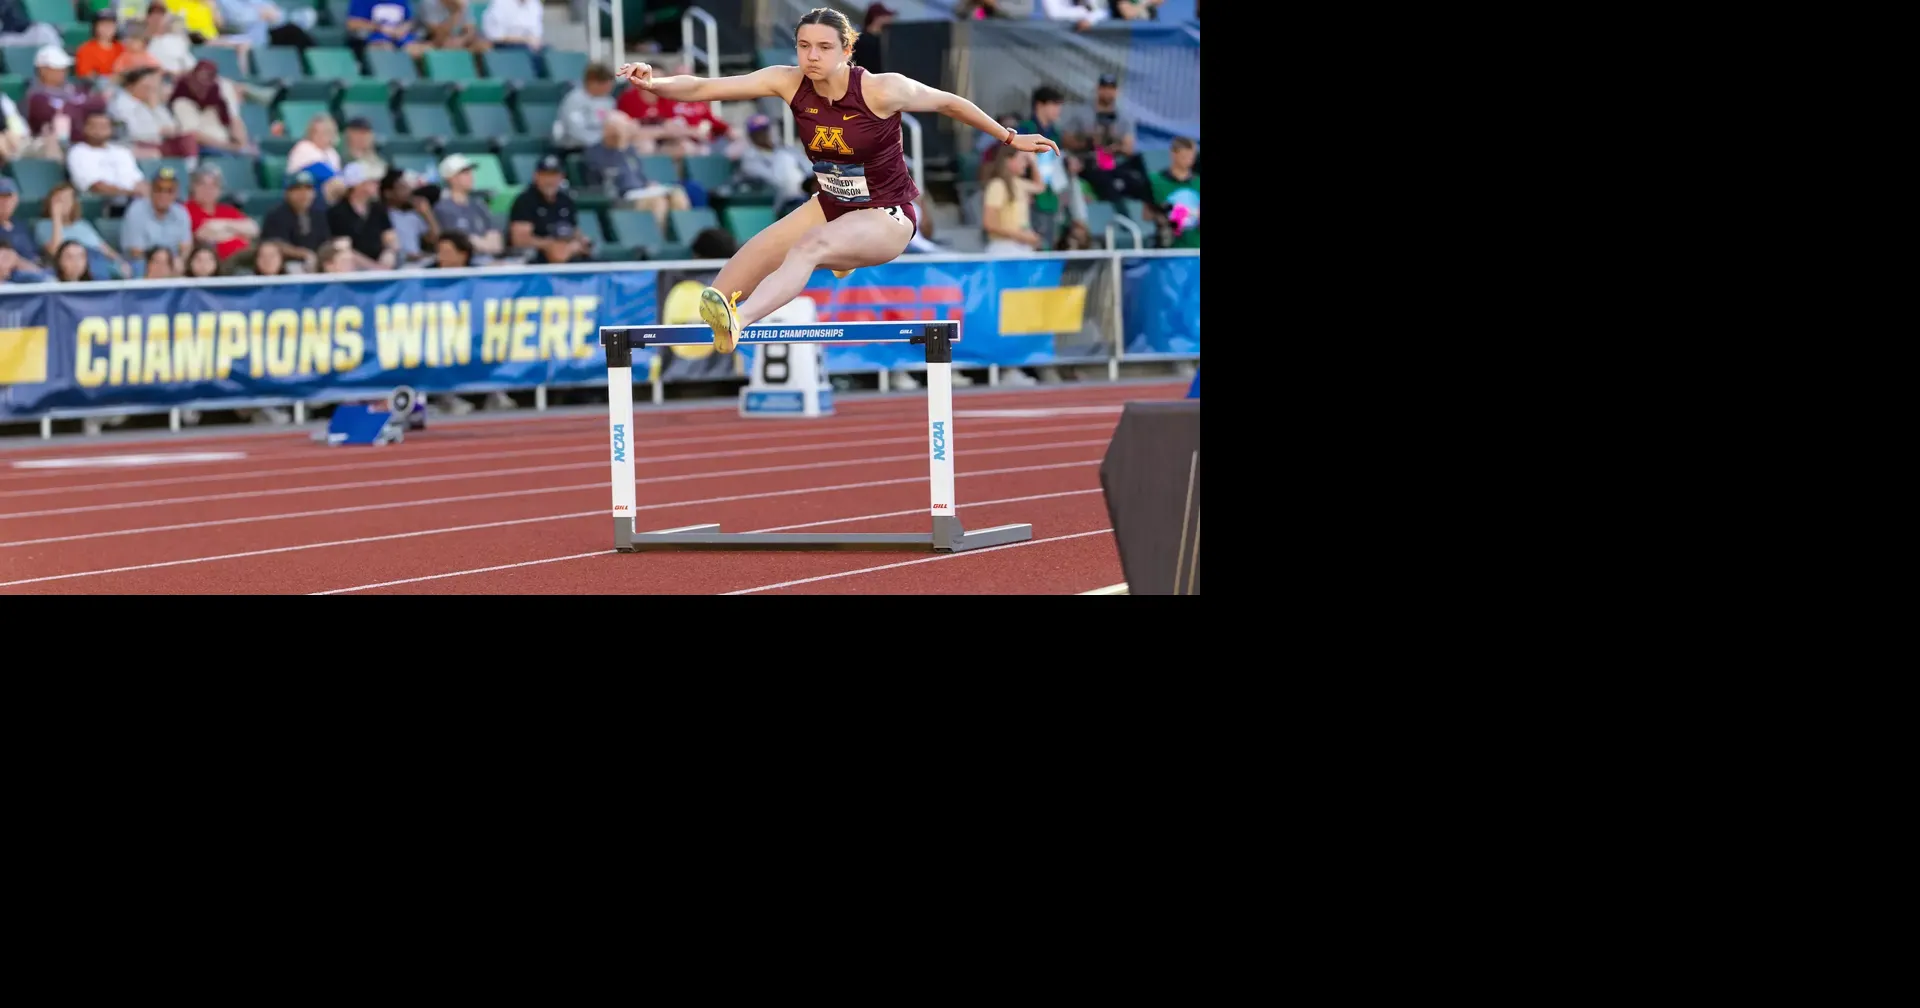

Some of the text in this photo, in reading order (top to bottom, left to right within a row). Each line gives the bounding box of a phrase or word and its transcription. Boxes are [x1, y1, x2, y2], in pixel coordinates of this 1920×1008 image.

[808, 125, 854, 155] M
[75, 295, 599, 388] CHAMPIONS WIN HERE
[750, 330, 757, 339] &
[757, 329, 778, 339] FIELD
[779, 328, 845, 338] CHAMPIONSHIPS
[613, 424, 625, 462] NCAA
[933, 421, 946, 461] NCAA
